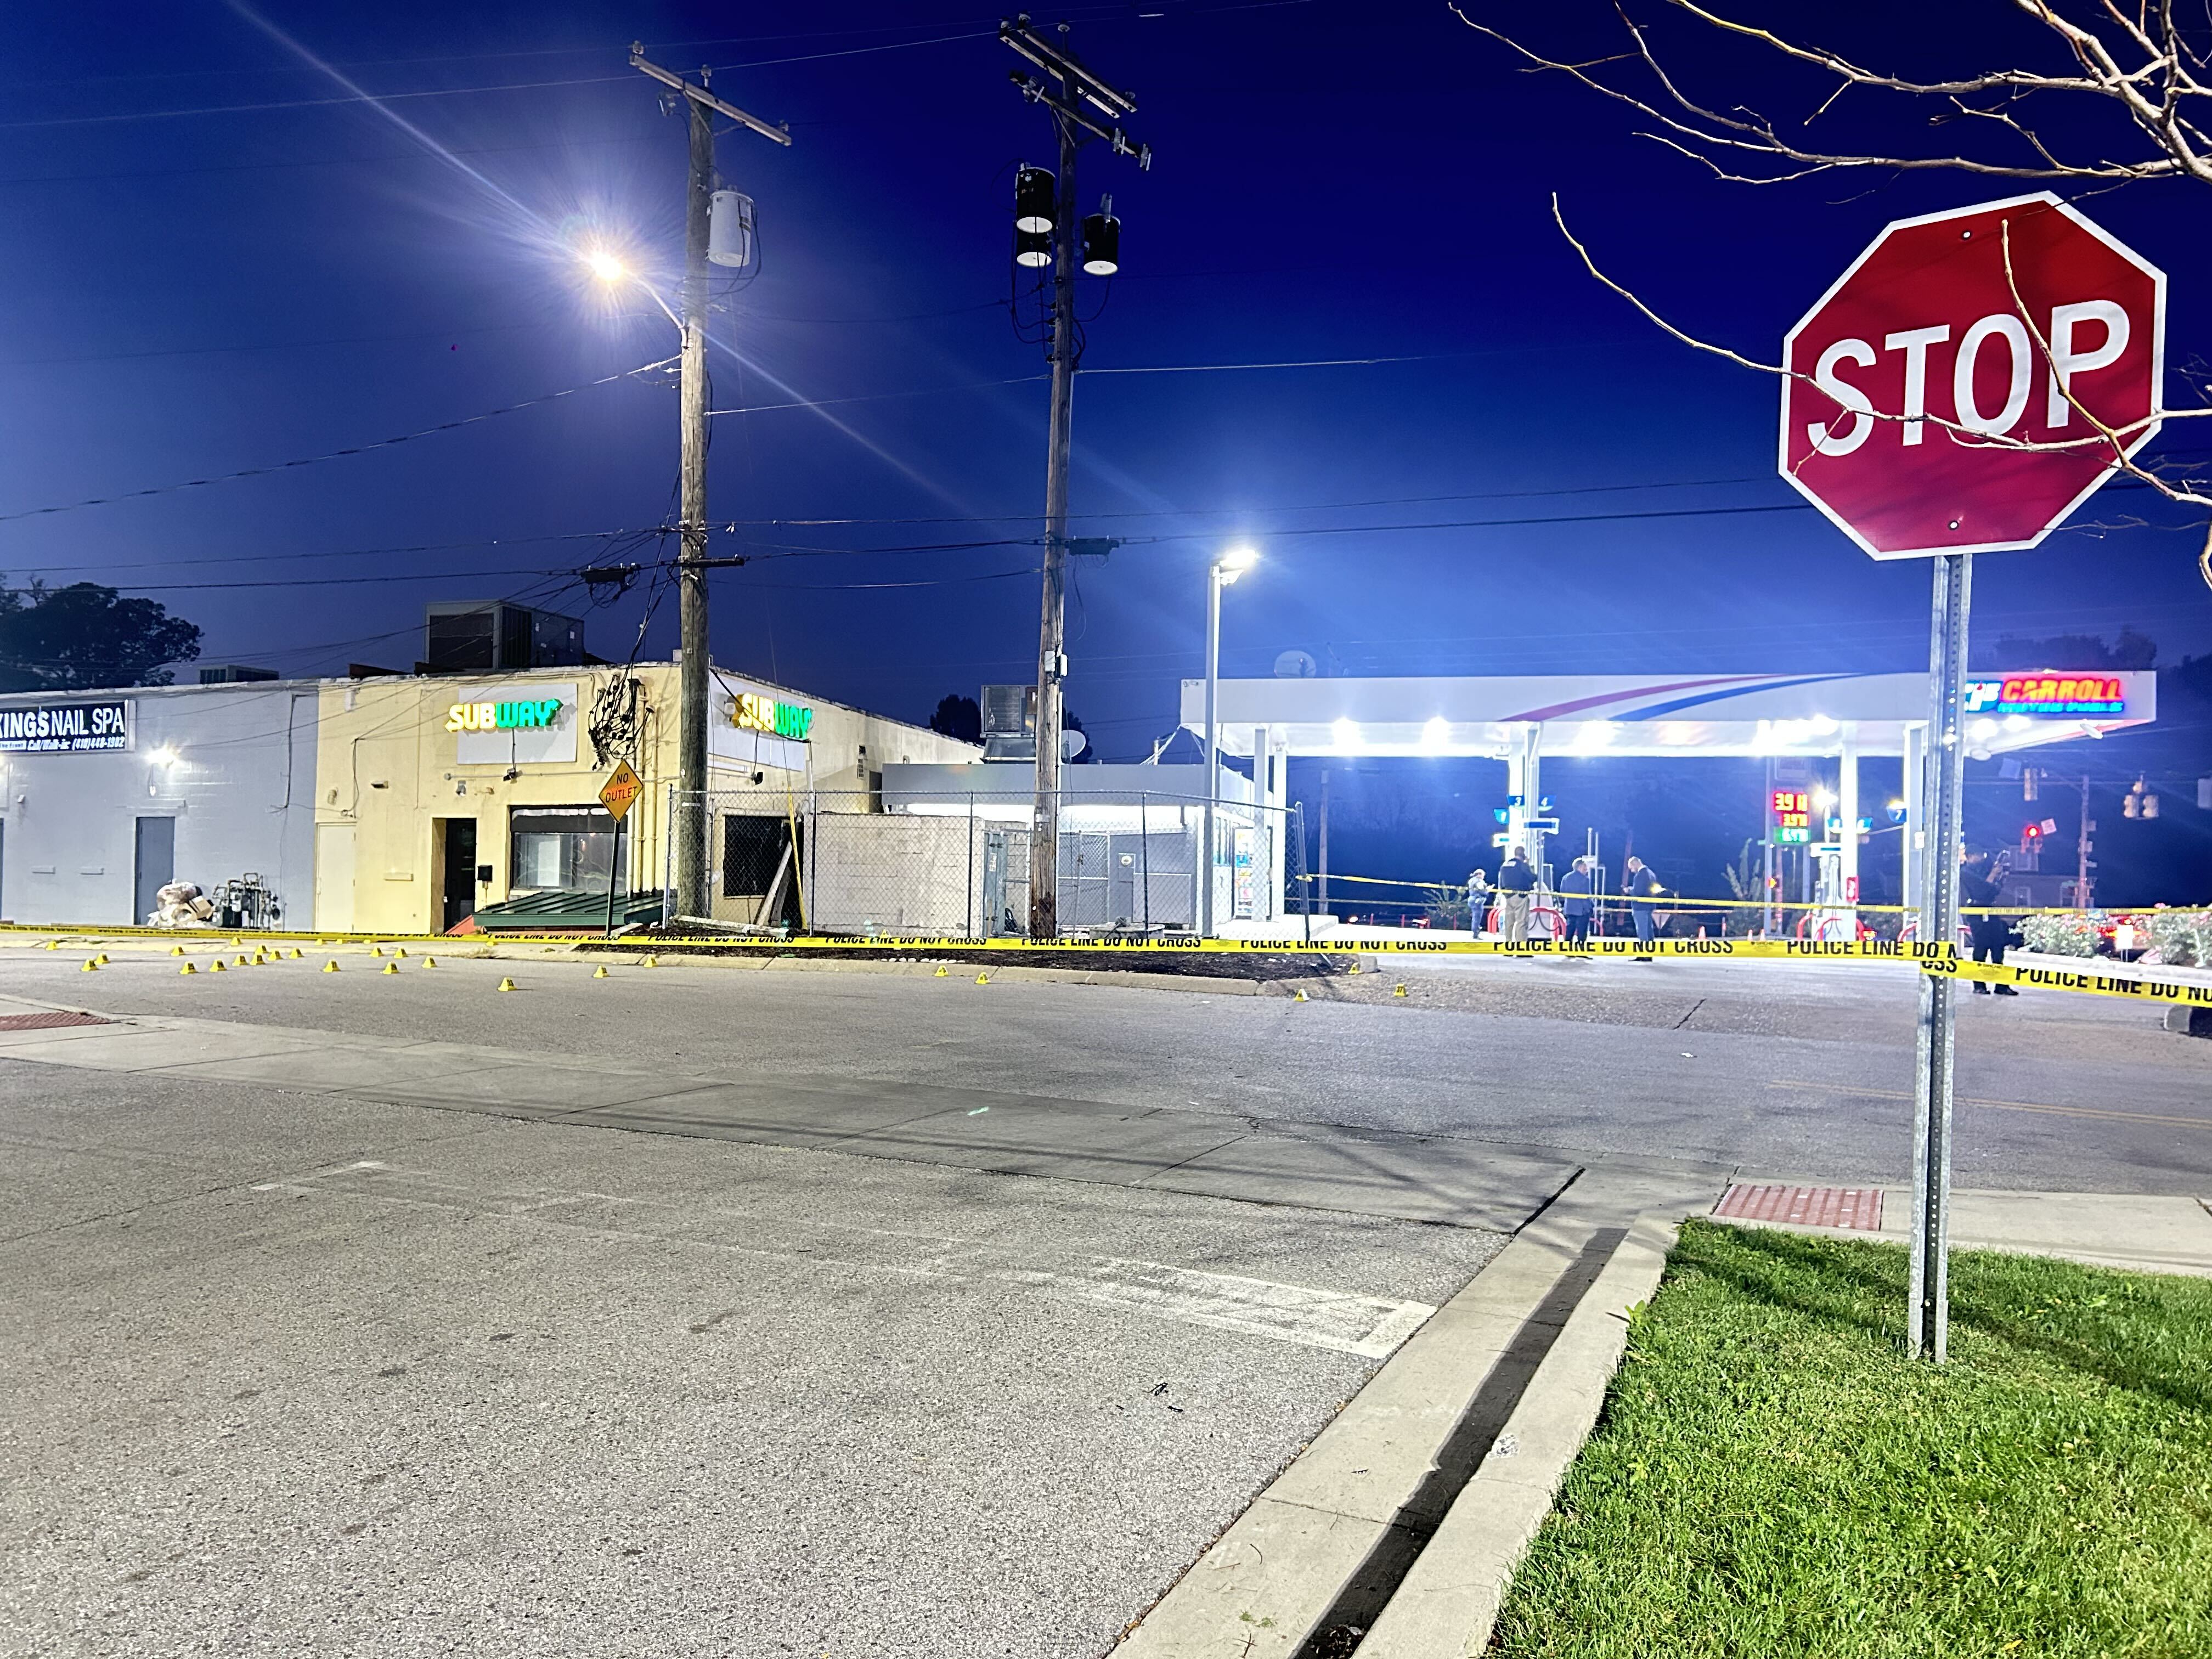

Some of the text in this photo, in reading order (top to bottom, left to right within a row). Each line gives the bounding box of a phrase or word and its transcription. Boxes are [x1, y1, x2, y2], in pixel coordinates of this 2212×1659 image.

[1808, 300, 2130, 457] STOP
[2002, 679, 2124, 701] CARROLL
[51, 709, 89, 736] NAIL
[92, 707, 125, 734] SPA
[444, 698, 563, 733] SUBWAY
[737, 693, 812, 740] SUBWAY
[617, 772, 629, 785] NO
[606, 786, 637, 803] OUTLET
[1862, 940, 1904, 956] LINE
[1912, 942, 1939, 958] DO
